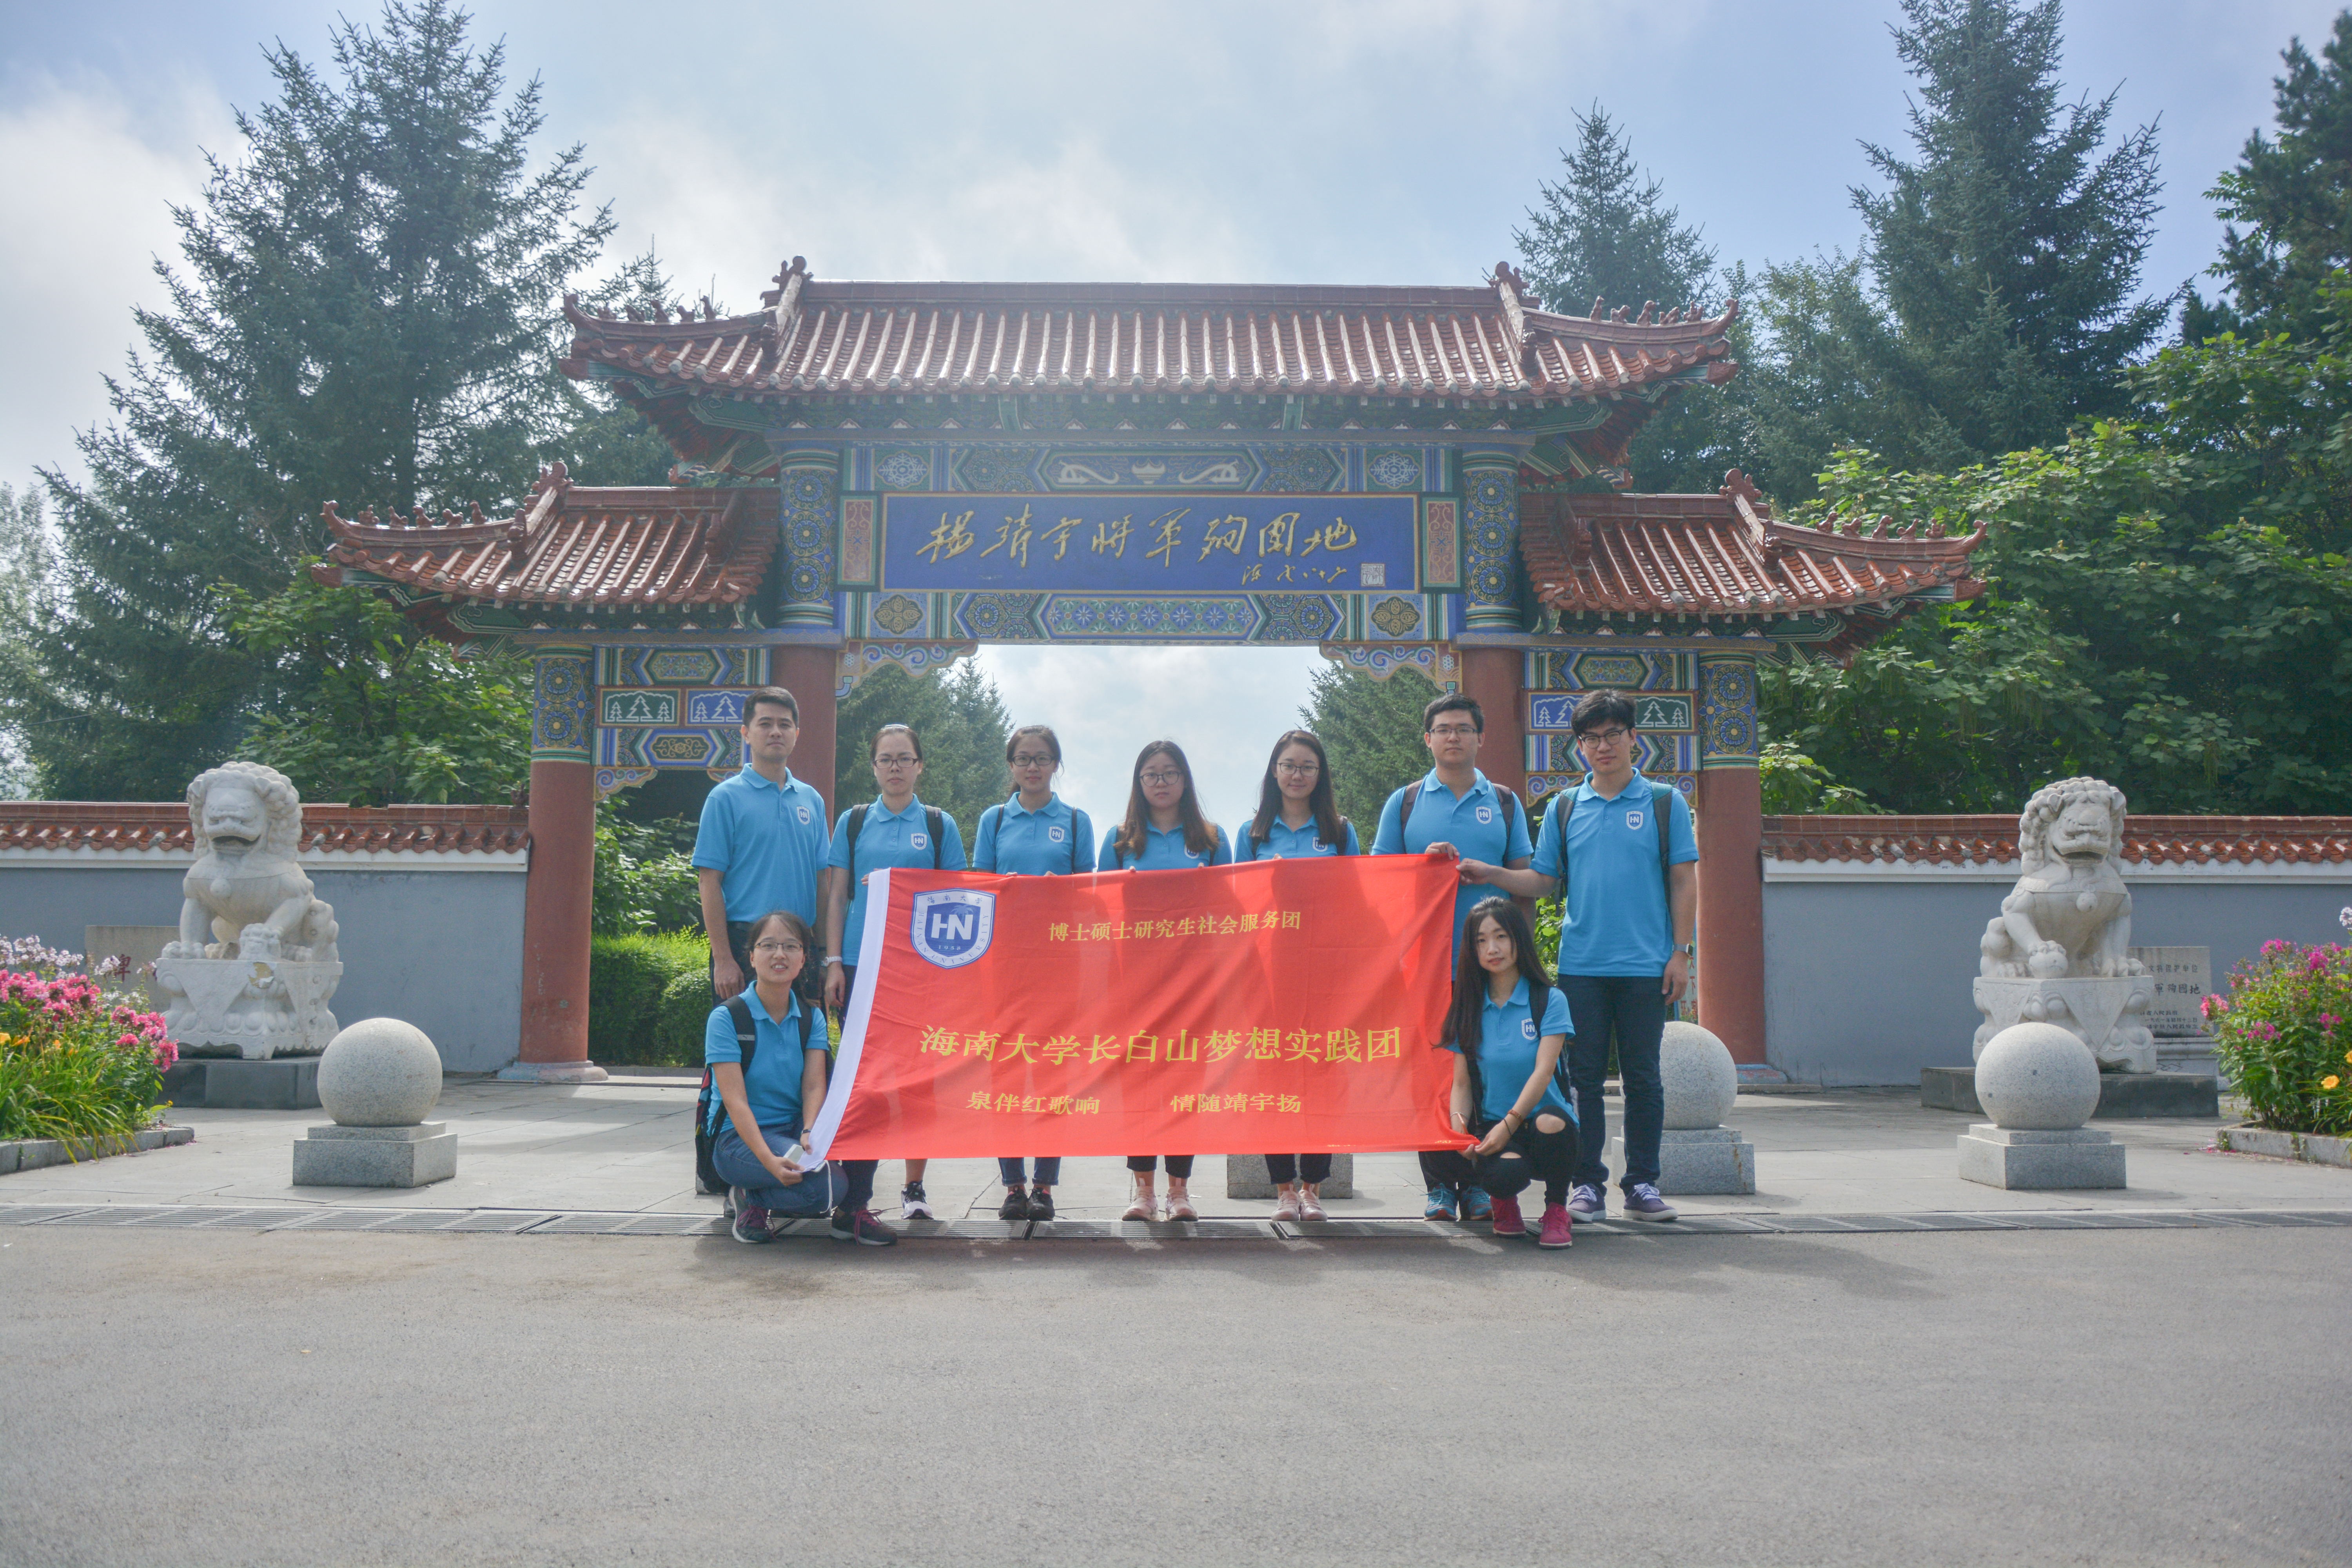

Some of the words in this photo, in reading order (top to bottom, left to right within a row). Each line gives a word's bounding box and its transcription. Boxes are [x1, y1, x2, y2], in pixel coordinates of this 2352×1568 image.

[931, 913, 974, 940] HN
[1048, 911, 1301, 942] 博士硕士研究生社会服务团
[920, 1025, 1401, 1065] 海南大学长白山梦想实践团
[965, 1091, 1100, 1114] 泉伴红歌响
[1170, 1093, 1301, 1113] 情随靖宇扬
